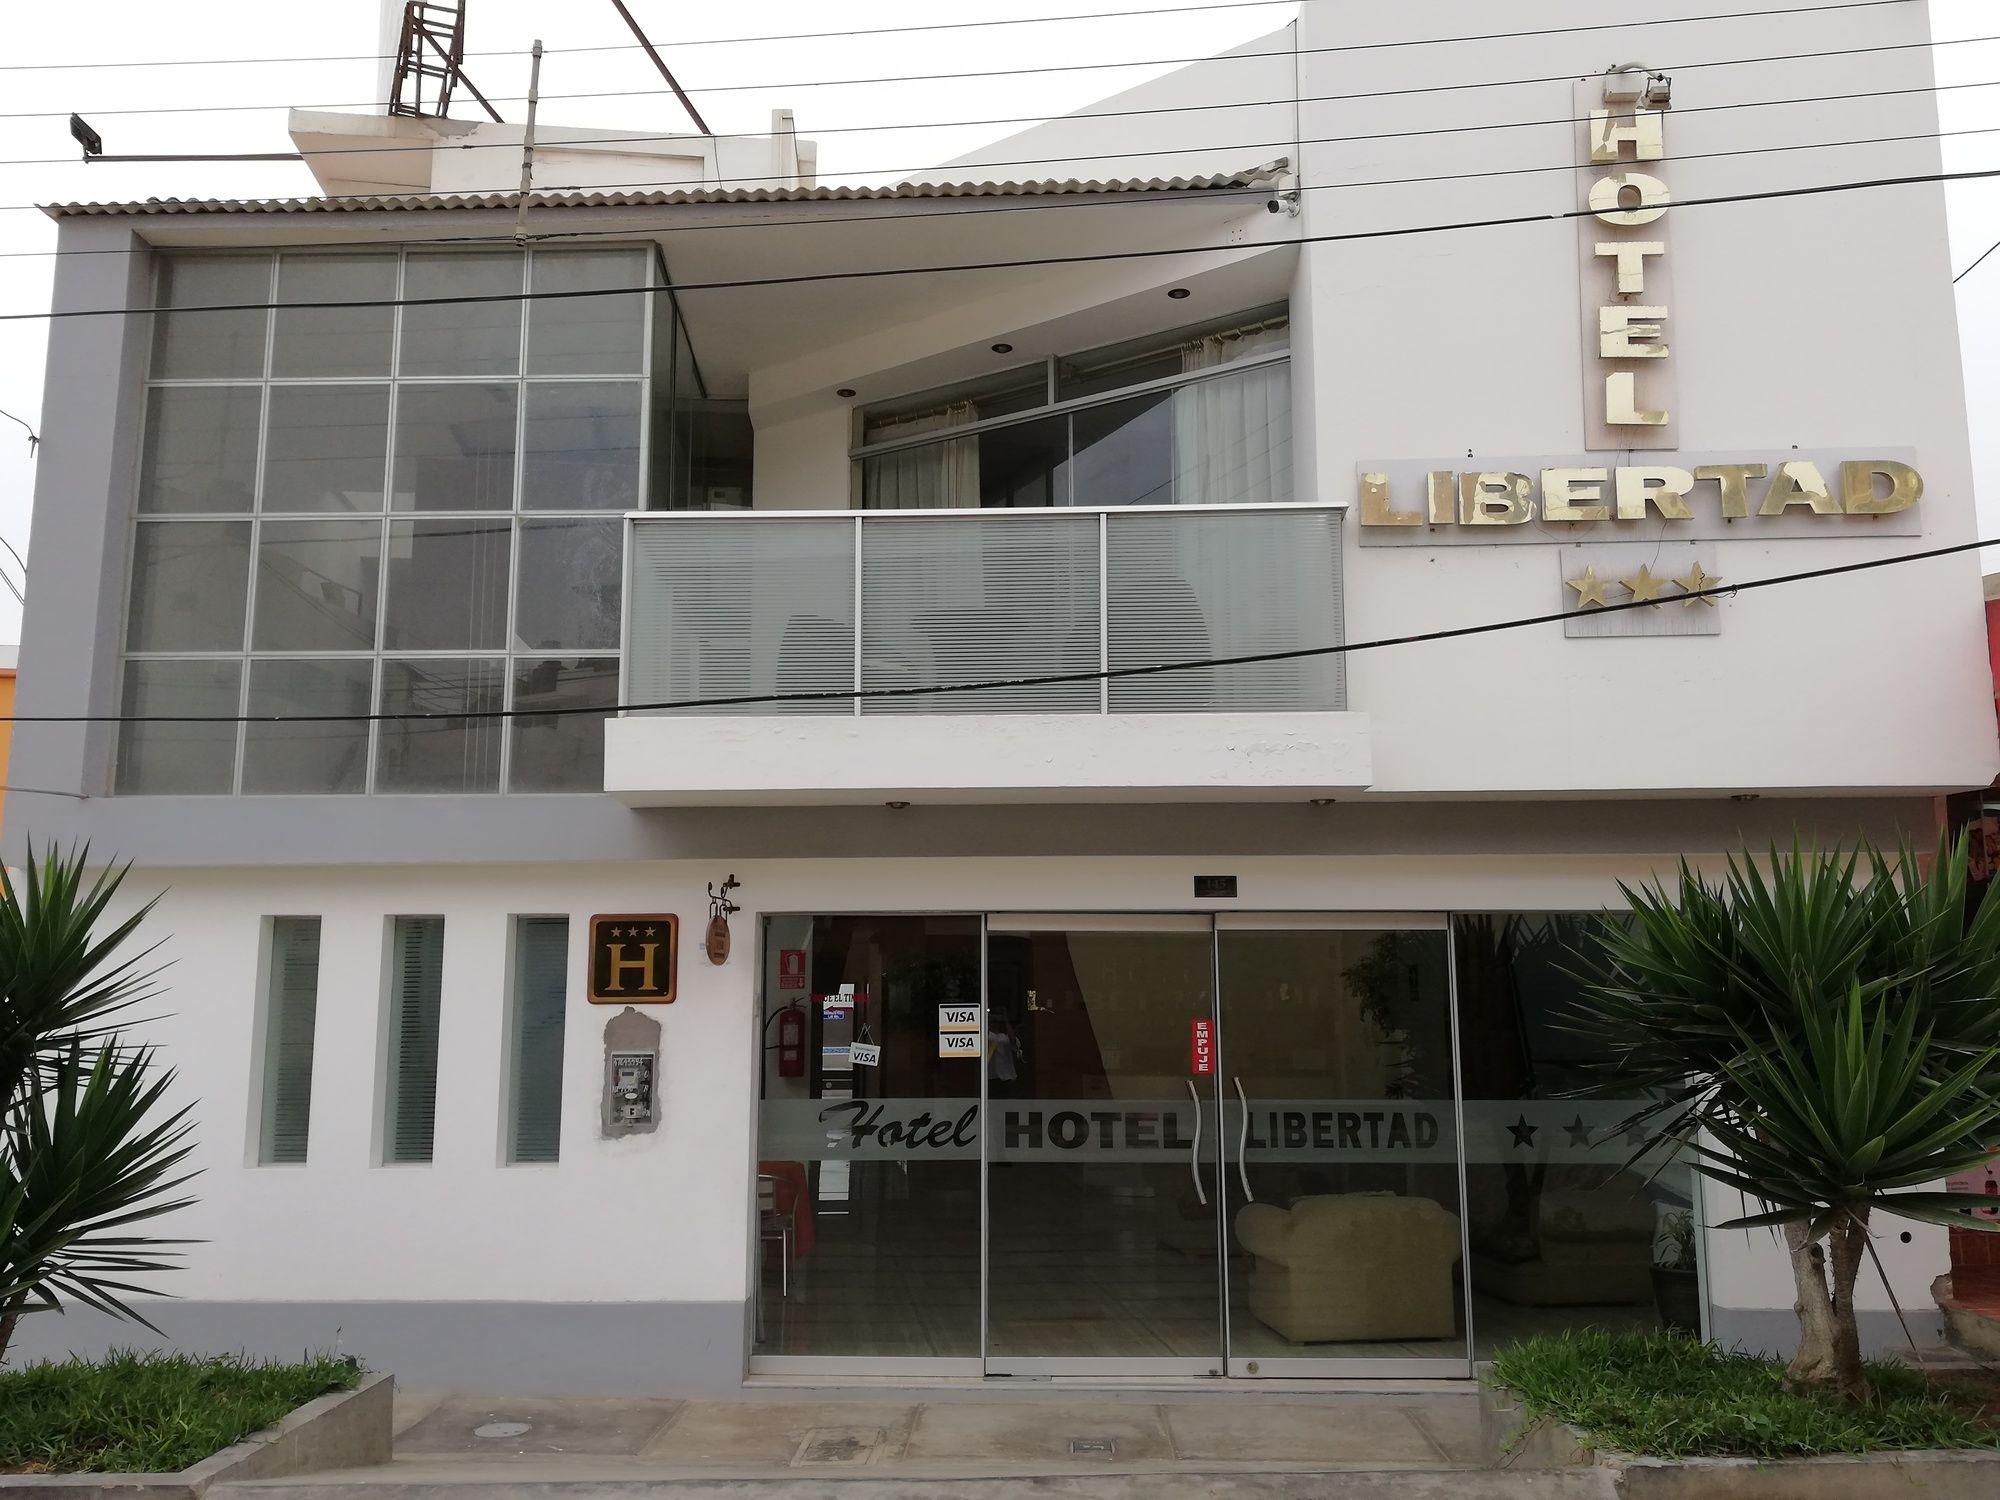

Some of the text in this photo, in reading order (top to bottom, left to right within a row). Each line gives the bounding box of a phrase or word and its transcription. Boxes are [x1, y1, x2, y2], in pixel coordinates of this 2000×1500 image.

[1588, 108, 1671, 427] HOTEL
[1359, 459, 1925, 527] LIBERTAD
[604, 943, 660, 991] H
[945, 1011, 975, 1023] VISA
[853, 1052, 876, 1064] VISA
[945, 1037, 975, 1048] VISA
[1196, 1022, 1209, 1072] EMPUJE
[818, 1100, 979, 1149] Hotel
[1004, 1111, 1439, 1149] HOTEL LIBERTAD
